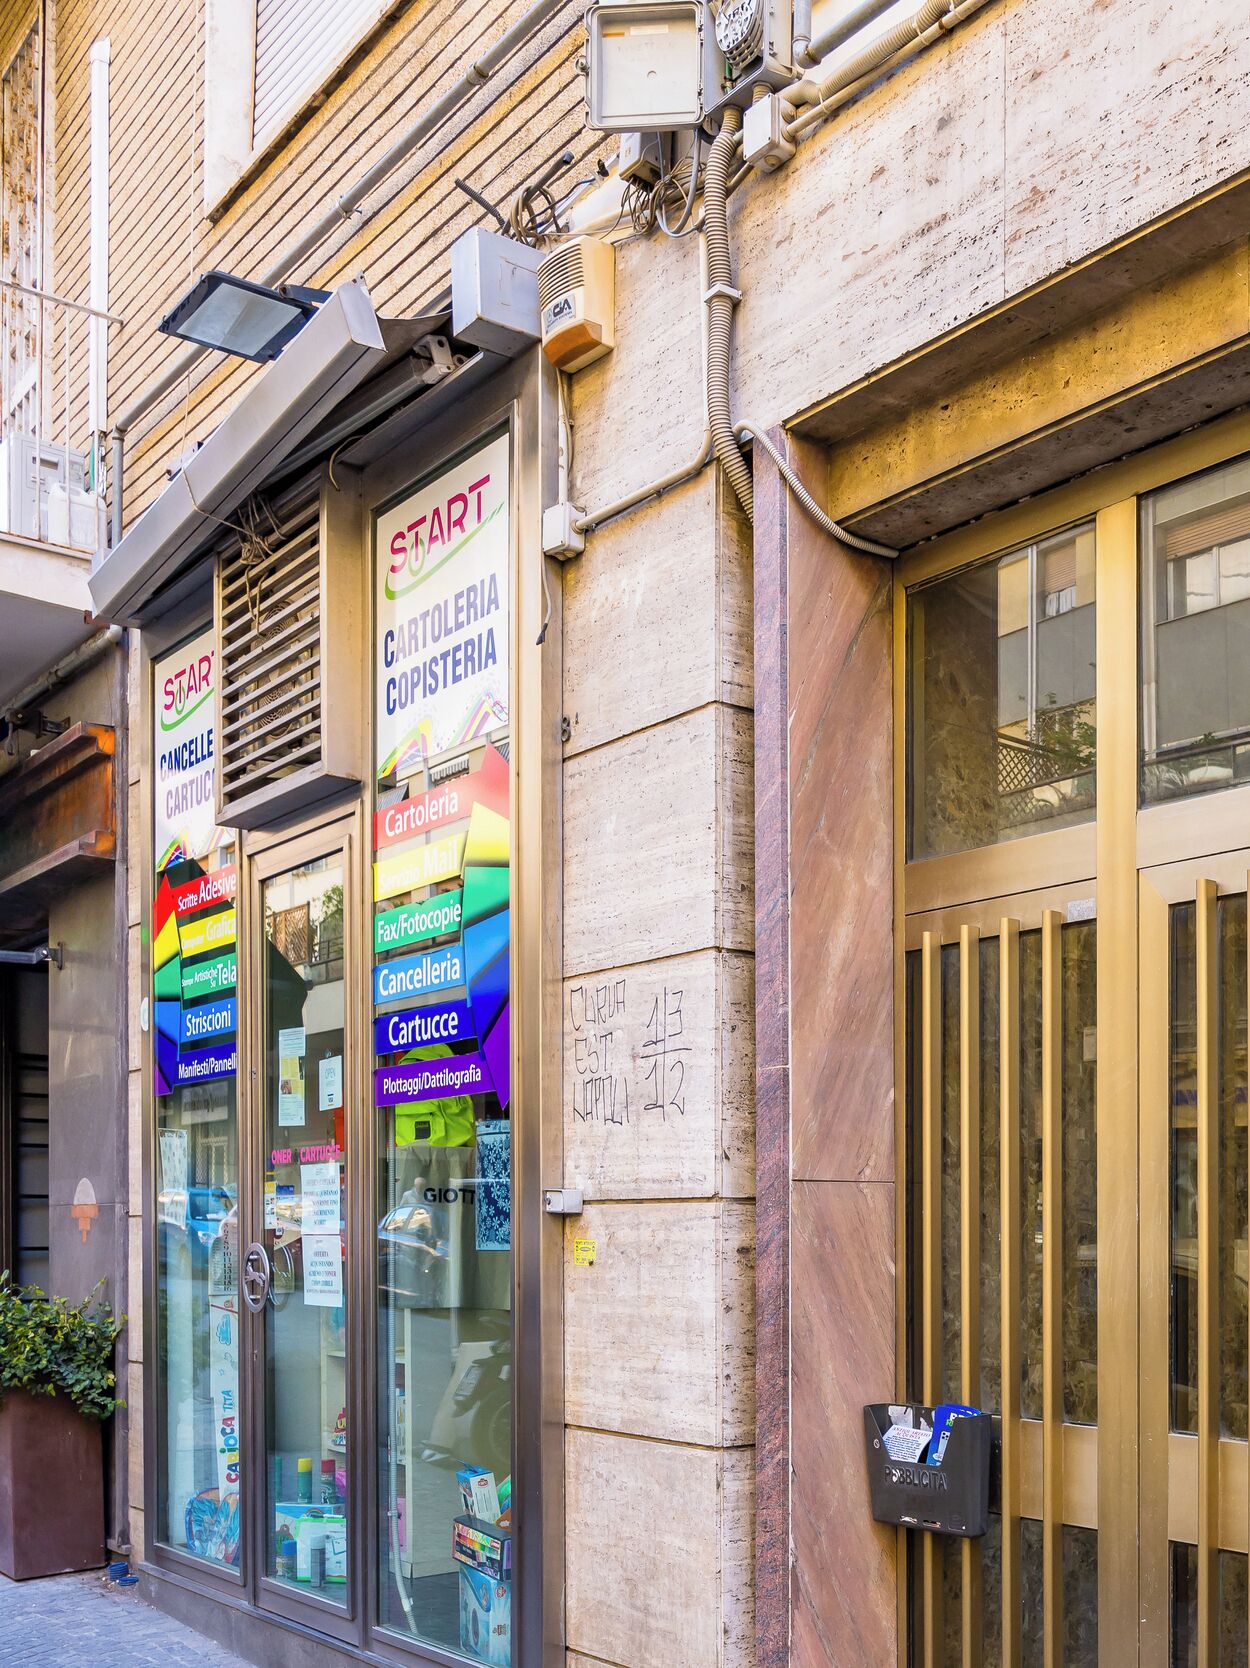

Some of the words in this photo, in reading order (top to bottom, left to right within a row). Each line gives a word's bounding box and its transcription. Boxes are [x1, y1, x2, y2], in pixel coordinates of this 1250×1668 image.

[390, 474, 490, 574] START
[384, 572, 500, 668] CARTOLERIA
[164, 650, 214, 711] STAR
[386, 627, 497, 716] COPISTERIA
[385, 787, 459, 837] Cartoleria
[423, 840, 458, 878] Mail
[177, 893, 198, 912] Scritte
[199, 872, 237, 904] Adesive
[378, 900, 462, 944] Fax/Fotocopie
[217, 960, 237, 986] Tela
[379, 953, 461, 996] Cancelleria
[186, 1003, 231, 1037] Striscioni
[388, 1011, 459, 1046] Cartucce
[574, 1032, 613, 1075] EST
[383, 1064, 482, 1096] Plottaggi/Dattilografia
[573, 1075, 630, 1126] NAPOLI
